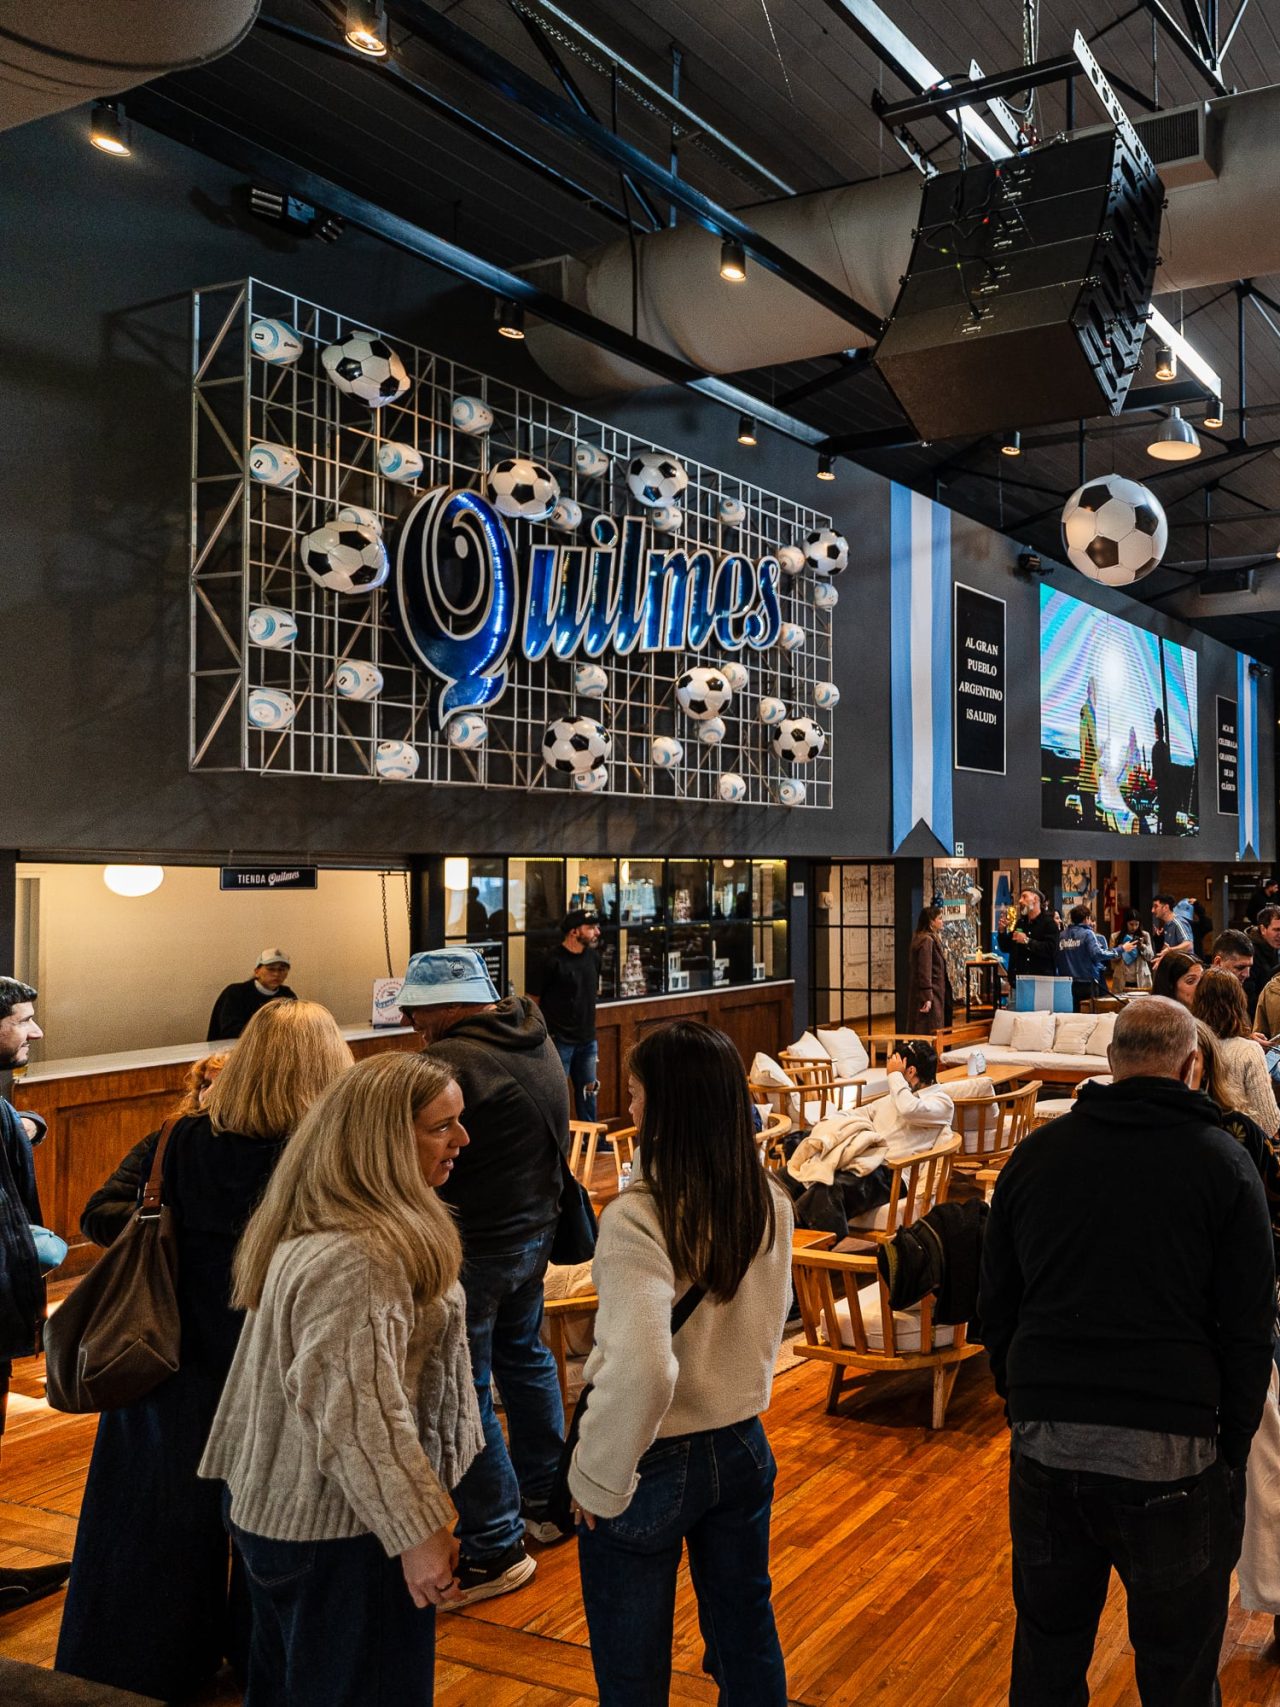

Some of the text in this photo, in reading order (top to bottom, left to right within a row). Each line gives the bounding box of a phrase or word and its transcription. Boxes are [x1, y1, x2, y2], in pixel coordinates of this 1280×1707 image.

[392, 486, 782, 731] Quilmes
[965, 637, 999, 656] AL GRAN
[967, 658, 997, 677] PUEBLO
[958, 681, 1003, 701] ARGENTINO
[966, 708, 997, 725] ¡SALUD!
[238, 871, 300, 886] TIENDA Quilmes
